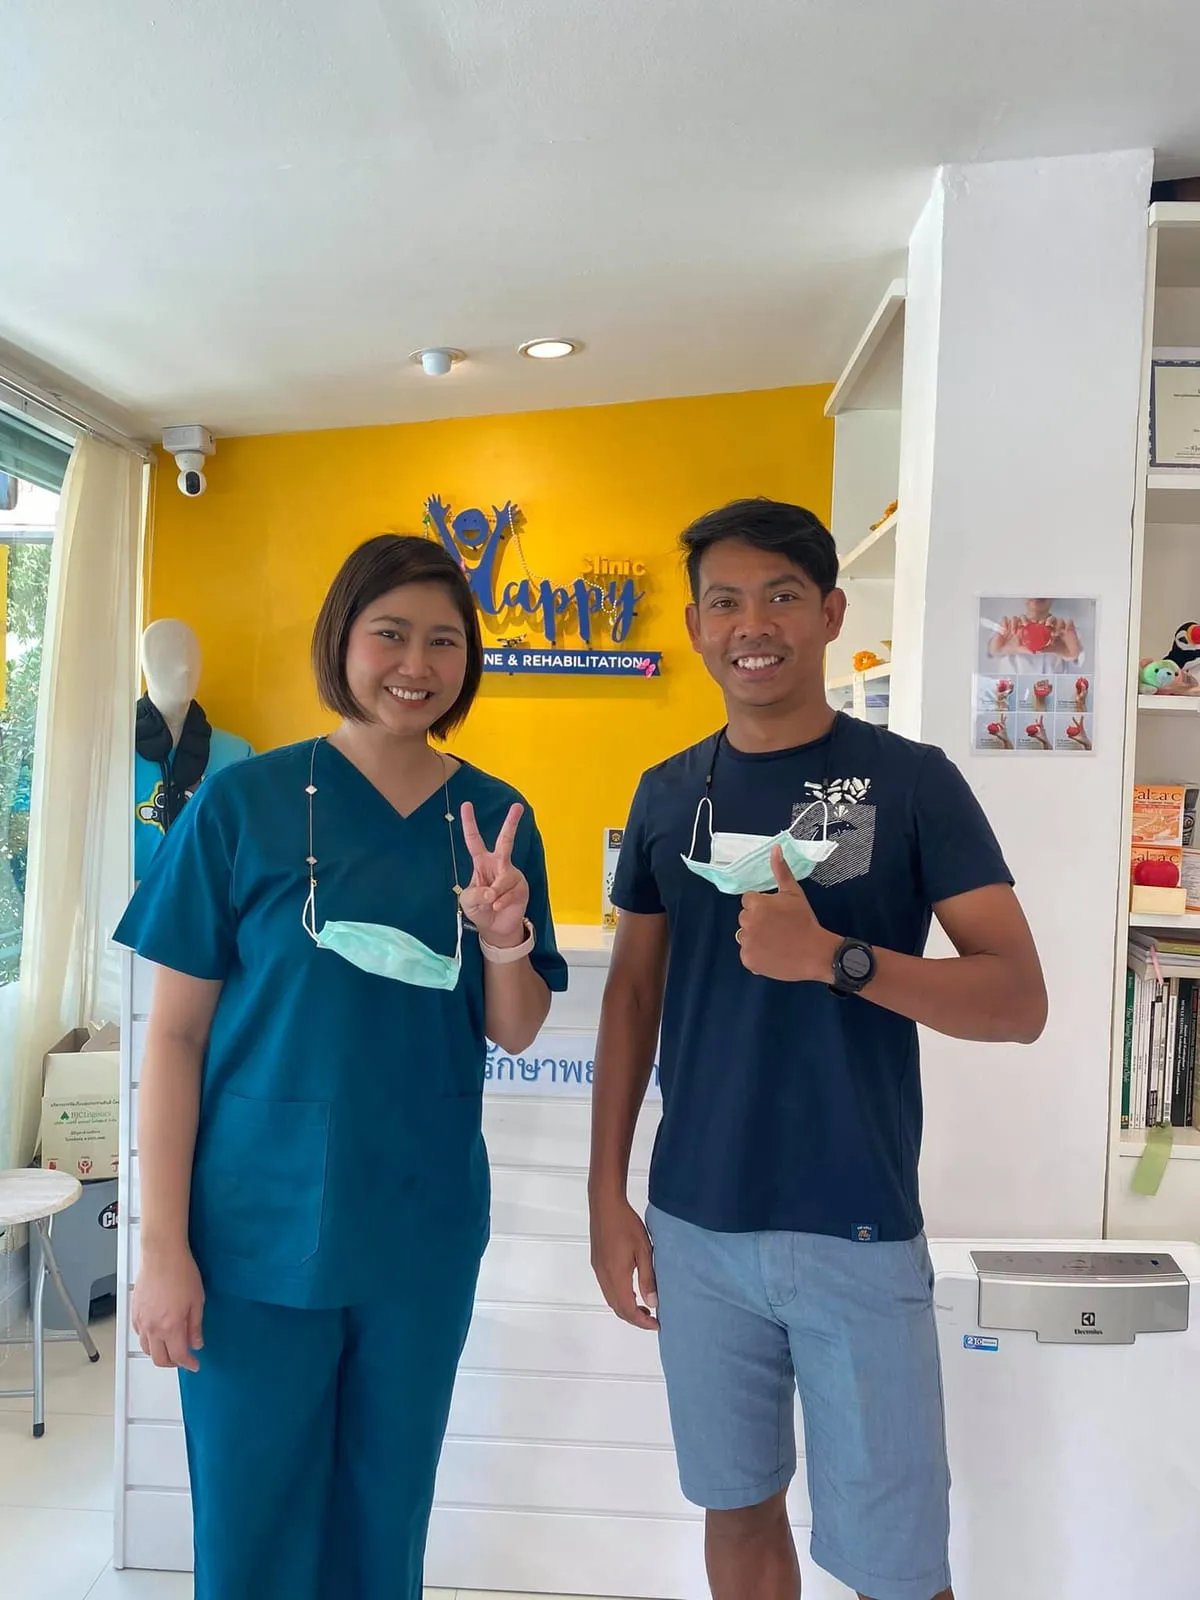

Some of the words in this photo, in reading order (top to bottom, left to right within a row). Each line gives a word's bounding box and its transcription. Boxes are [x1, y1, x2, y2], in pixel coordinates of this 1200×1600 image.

[484, 654, 503, 666] NE
[507, 655, 518, 666] &
[523, 655, 643, 669] REHABILITATION
